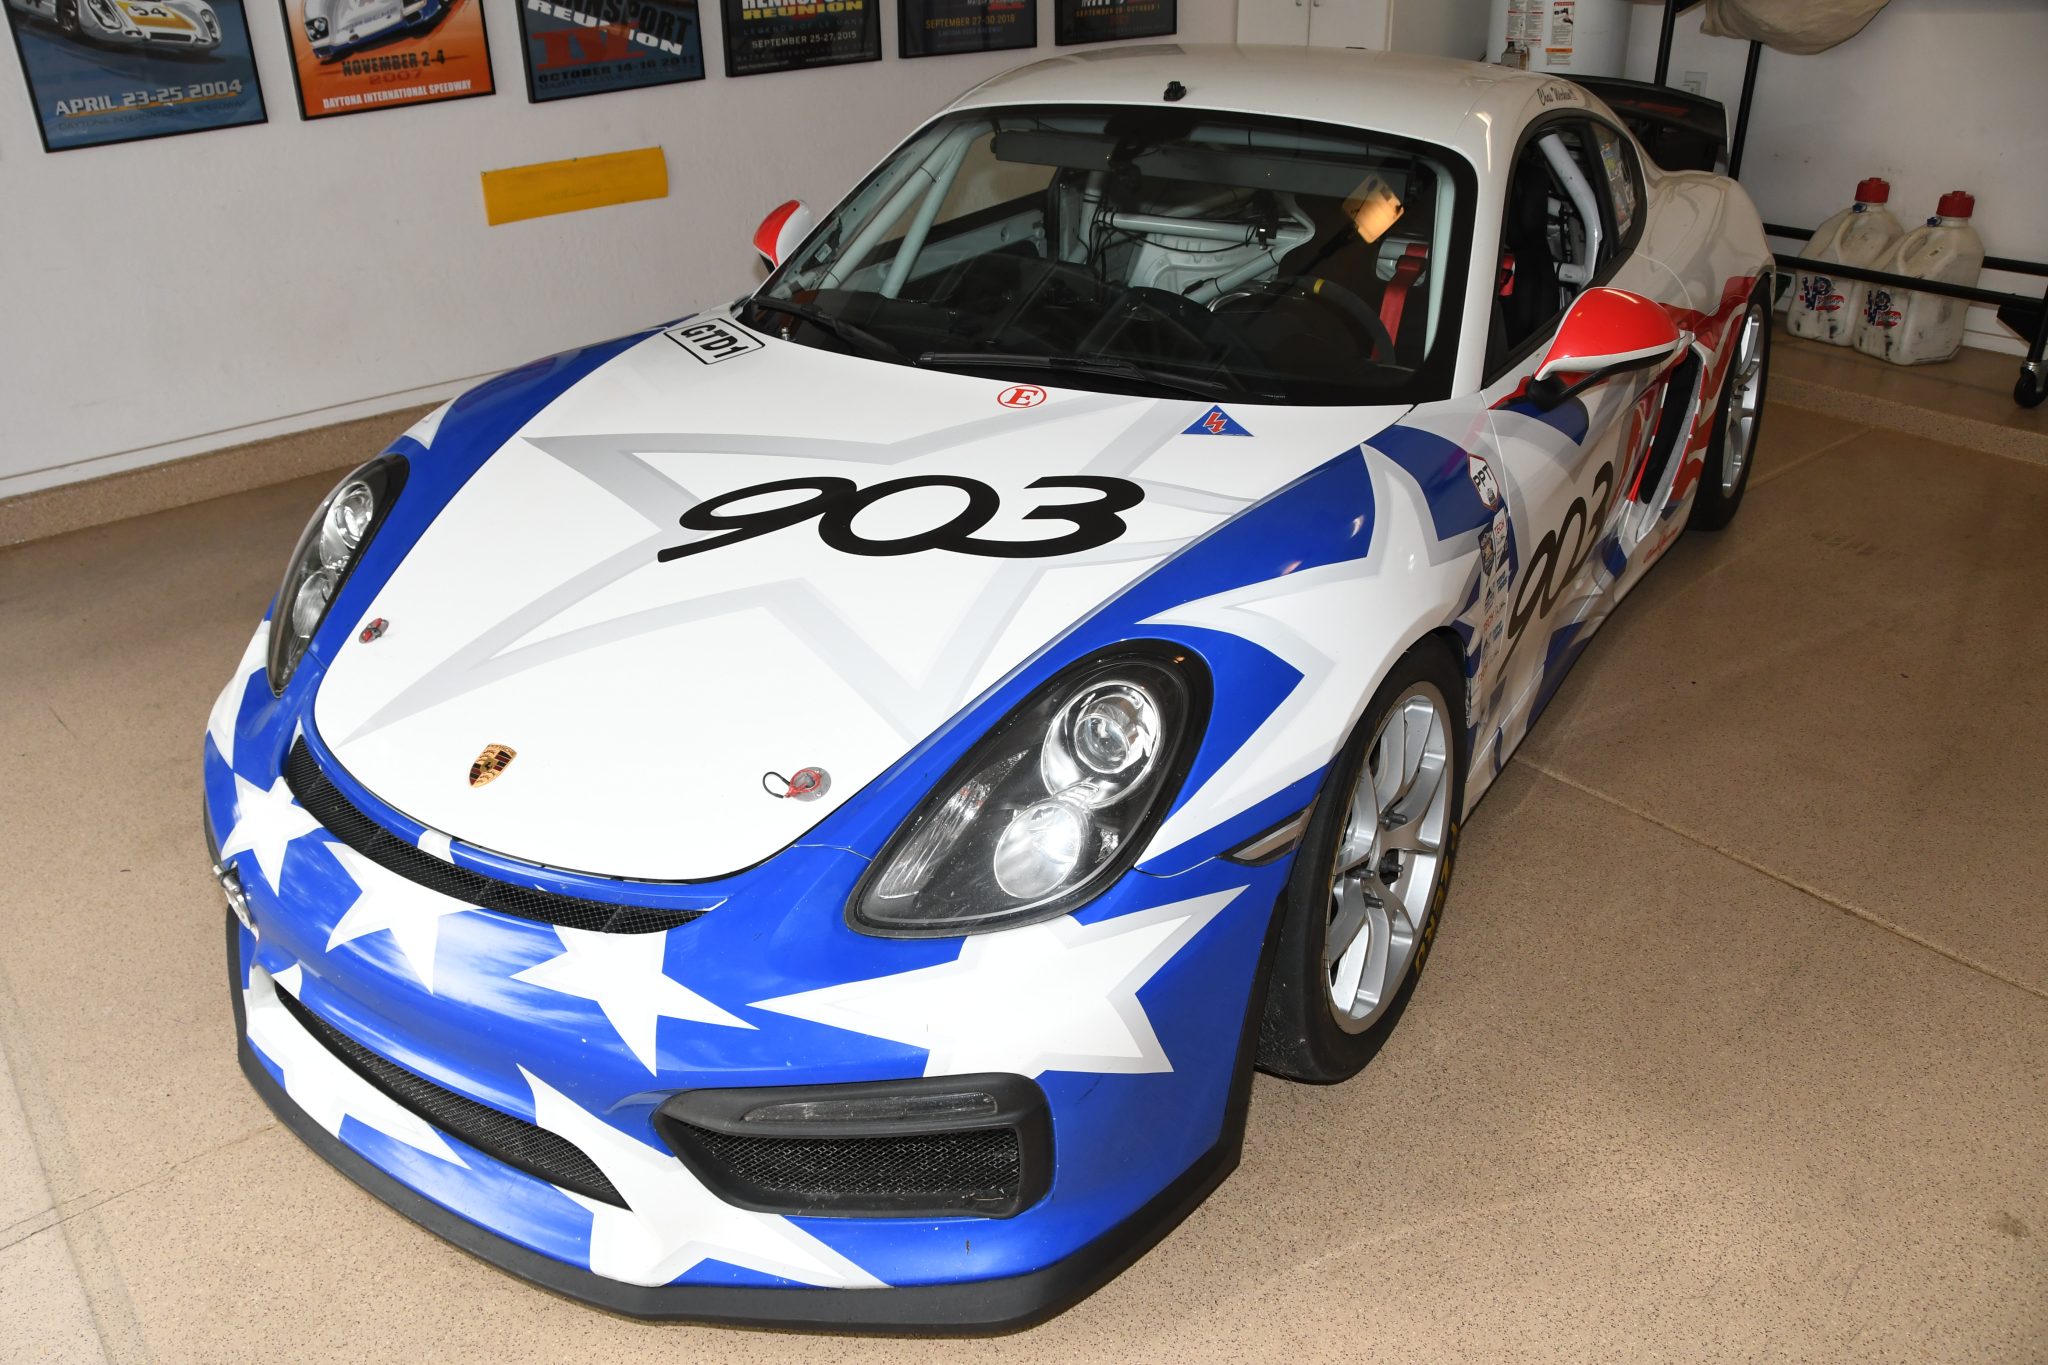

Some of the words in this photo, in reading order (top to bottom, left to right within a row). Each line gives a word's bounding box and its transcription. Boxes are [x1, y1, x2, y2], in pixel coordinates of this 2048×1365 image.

[742, 1, 863, 20] REUNION
[926, 17, 970, 29] SEPTEMBER
[752, 36, 807, 49] SEPTEMBER
[837, 30, 857, 40] 2015
[342, 53, 419, 76] NOVEMBER
[422, 49, 446, 66] 2-4
[538, 65, 611, 83] OCTOBER
[369, 70, 423, 85] 2007
[55, 95, 118, 116] APRIL
[121, 86, 184, 107] 23-25
[188, 79, 243, 98] 2004
[323, 92, 363, 109] DAYTONA
[364, 86, 428, 104] INTERNATIONAL
[429, 80, 472, 95] SPEEDWAY
[680, 324, 749, 359] GTD1
[1004, 388, 1039, 408] E
[1473, 465, 1492, 492] PPT
[657, 474, 1146, 563] 903
[1496, 460, 1614, 684] 903
